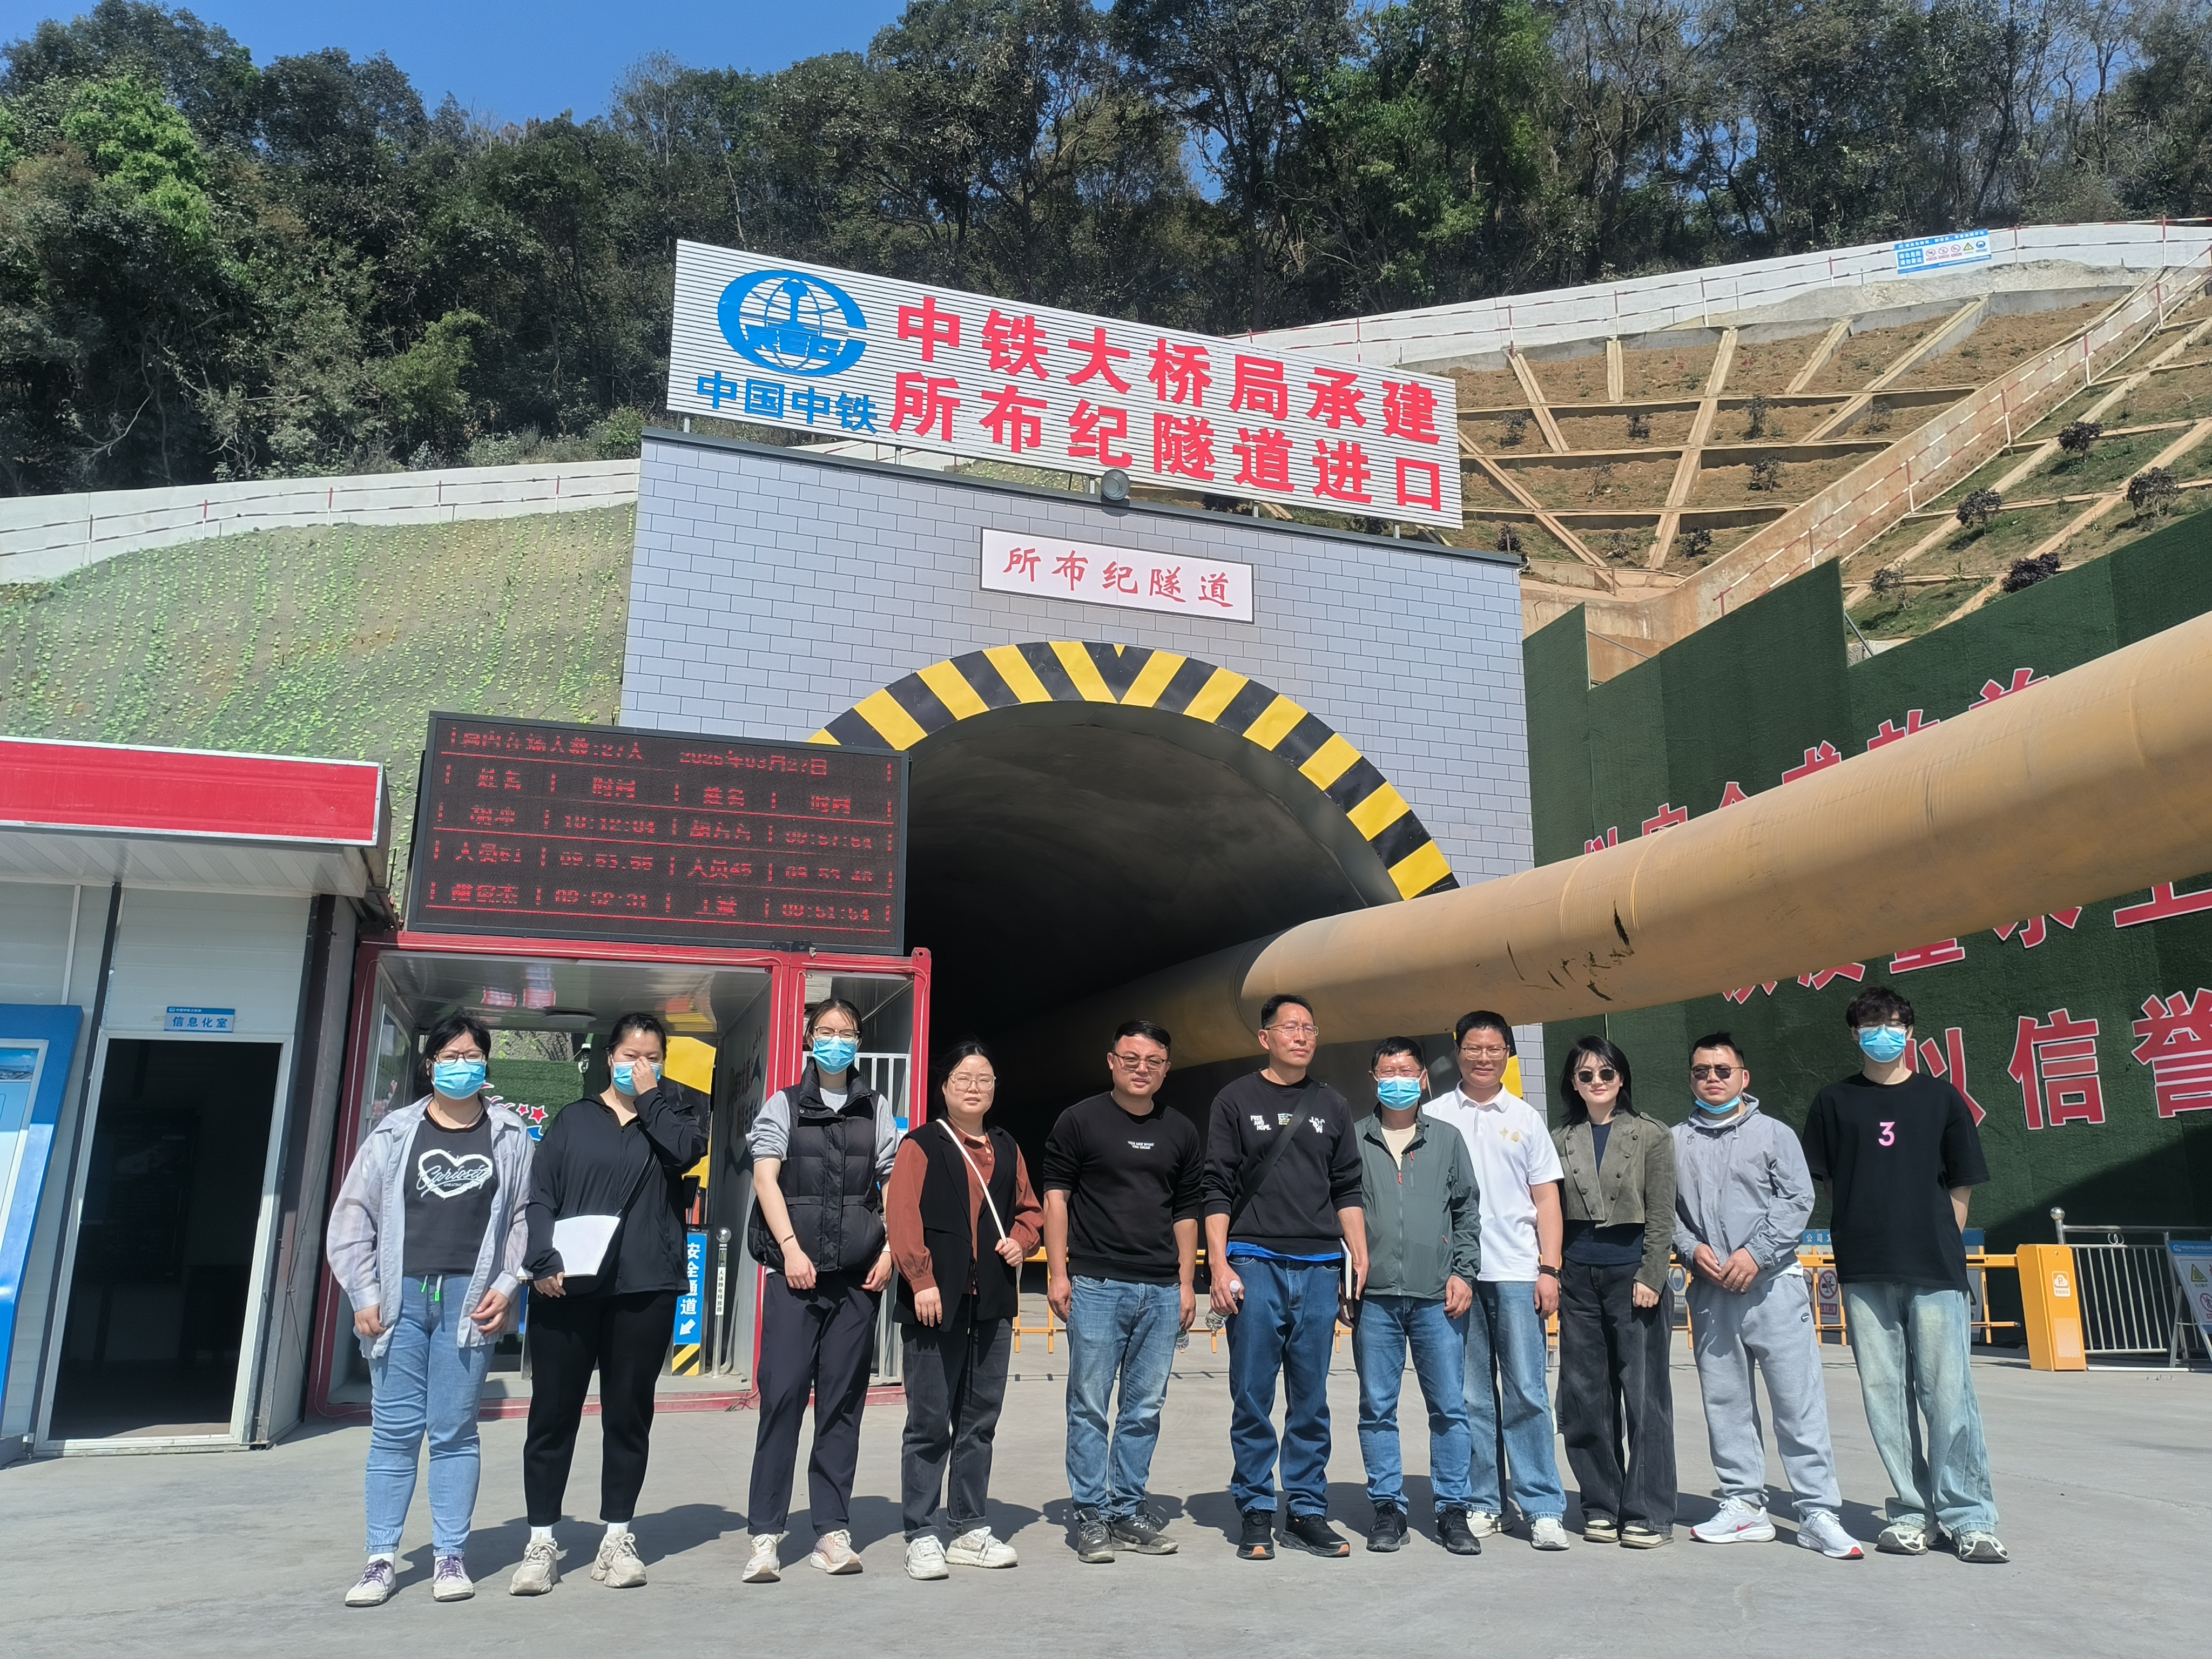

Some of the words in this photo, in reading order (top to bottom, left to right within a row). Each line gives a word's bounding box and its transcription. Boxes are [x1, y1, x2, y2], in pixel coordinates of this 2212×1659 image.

[898, 295, 1440, 444] 中铁大桥局承建
[697, 370, 879, 435] 中国中铁
[888, 371, 1442, 511] 所布纪隧道进口
[1003, 547, 1235, 607] 所布纪隧道
[172, 1016, 227, 1028] 信息化室
[1878, 1121, 1896, 1146] 3
[680, 1242, 701, 1316] 安全通道
